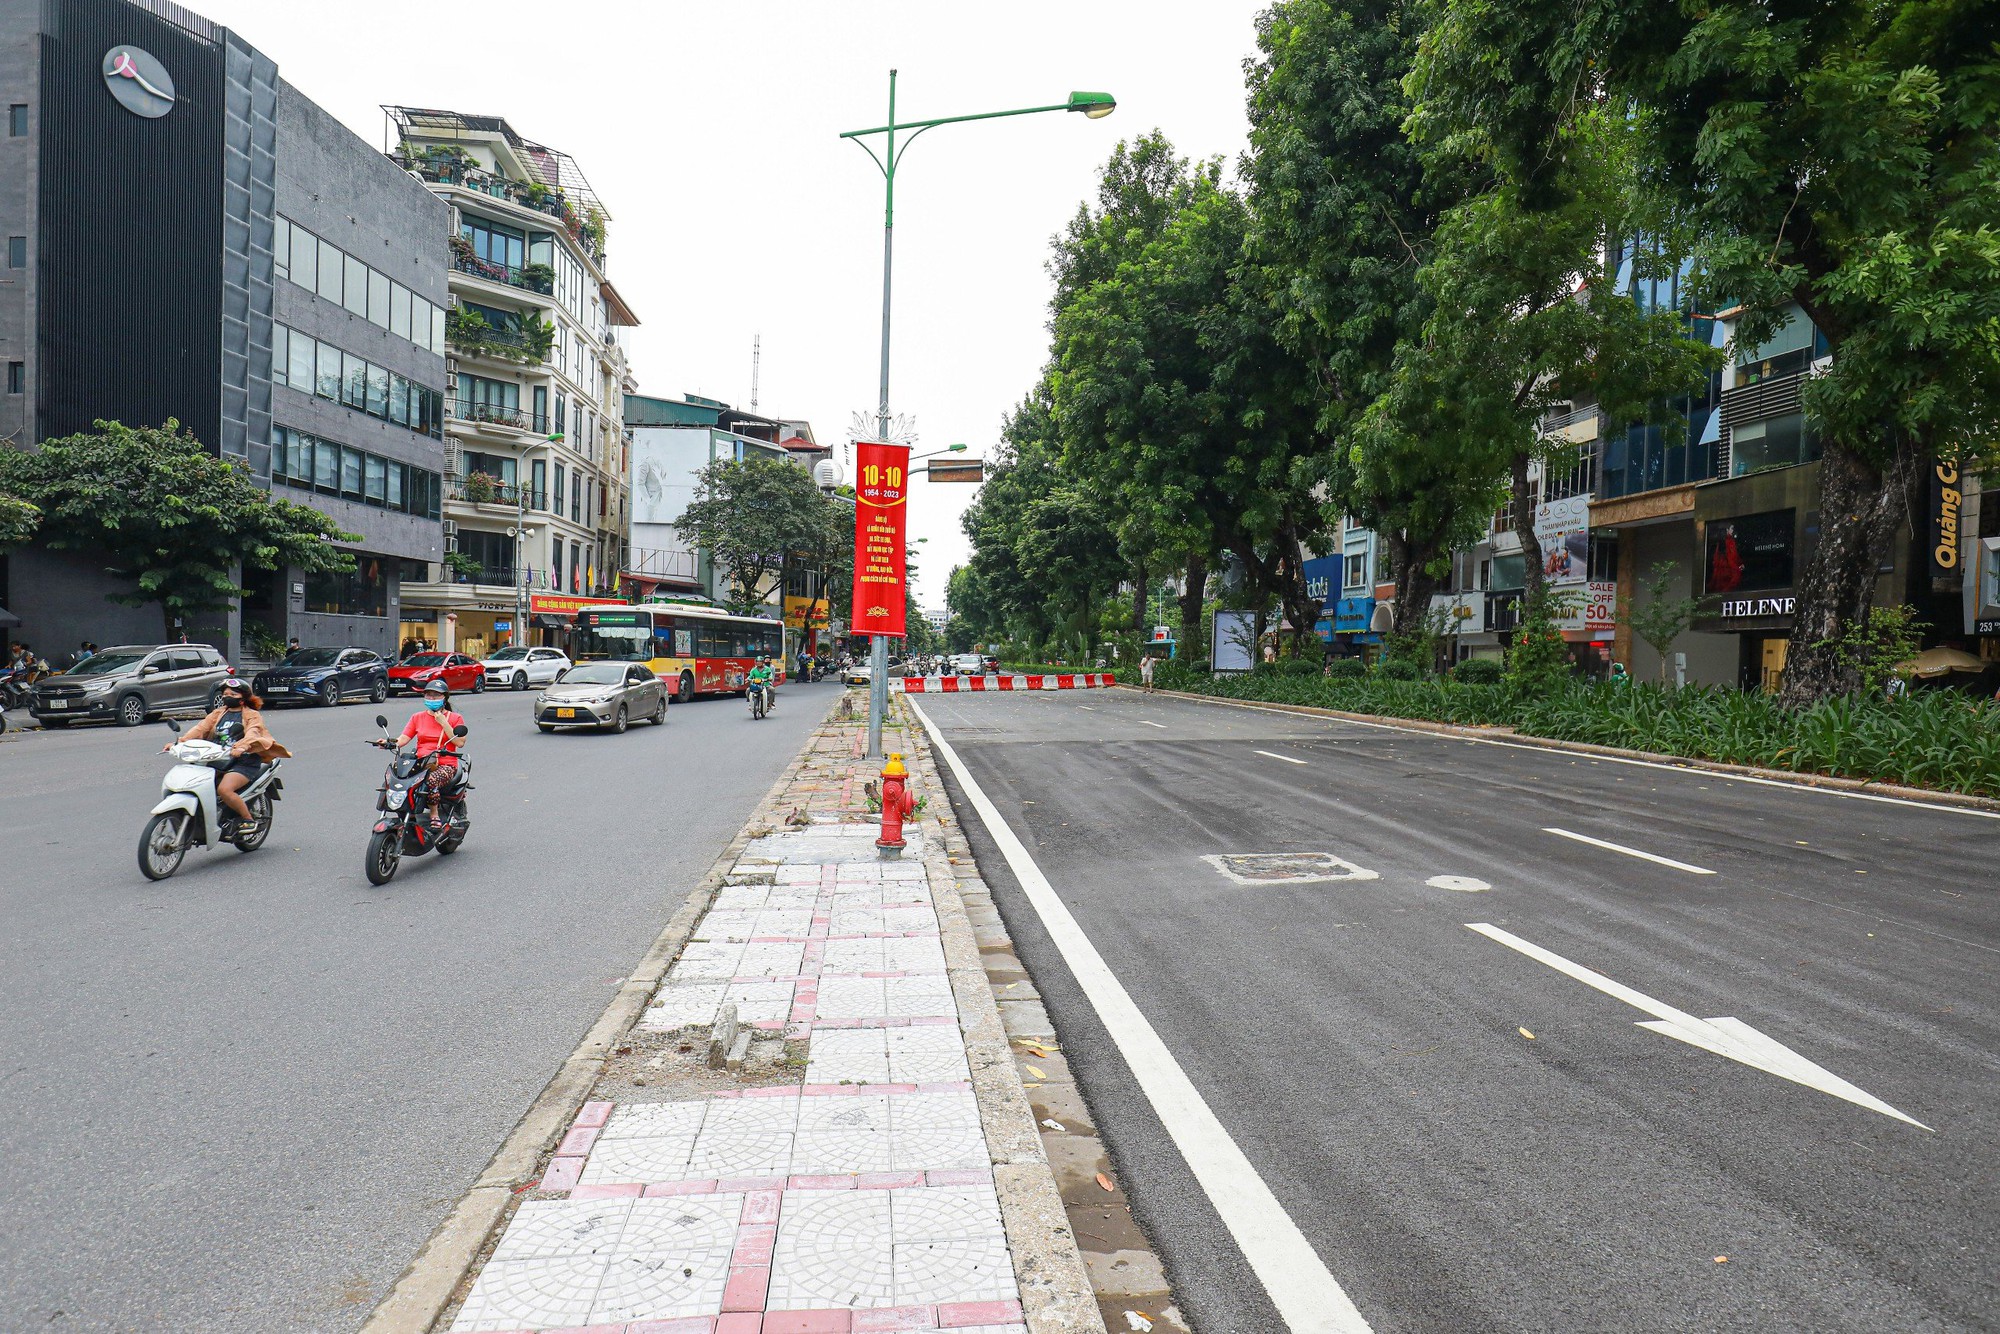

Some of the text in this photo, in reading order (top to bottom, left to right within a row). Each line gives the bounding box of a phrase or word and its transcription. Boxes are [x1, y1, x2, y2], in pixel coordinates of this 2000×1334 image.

[865, 489, 879, 497] 1954
[883, 490, 899, 498] 2023
[1935, 487, 1962, 568] Quảng
[1589, 583, 1614, 592] SALE
[1594, 594, 1614, 603] OFF
[1721, 597, 1796, 617] HELENE
[1979, 622, 1993, 632] 253
